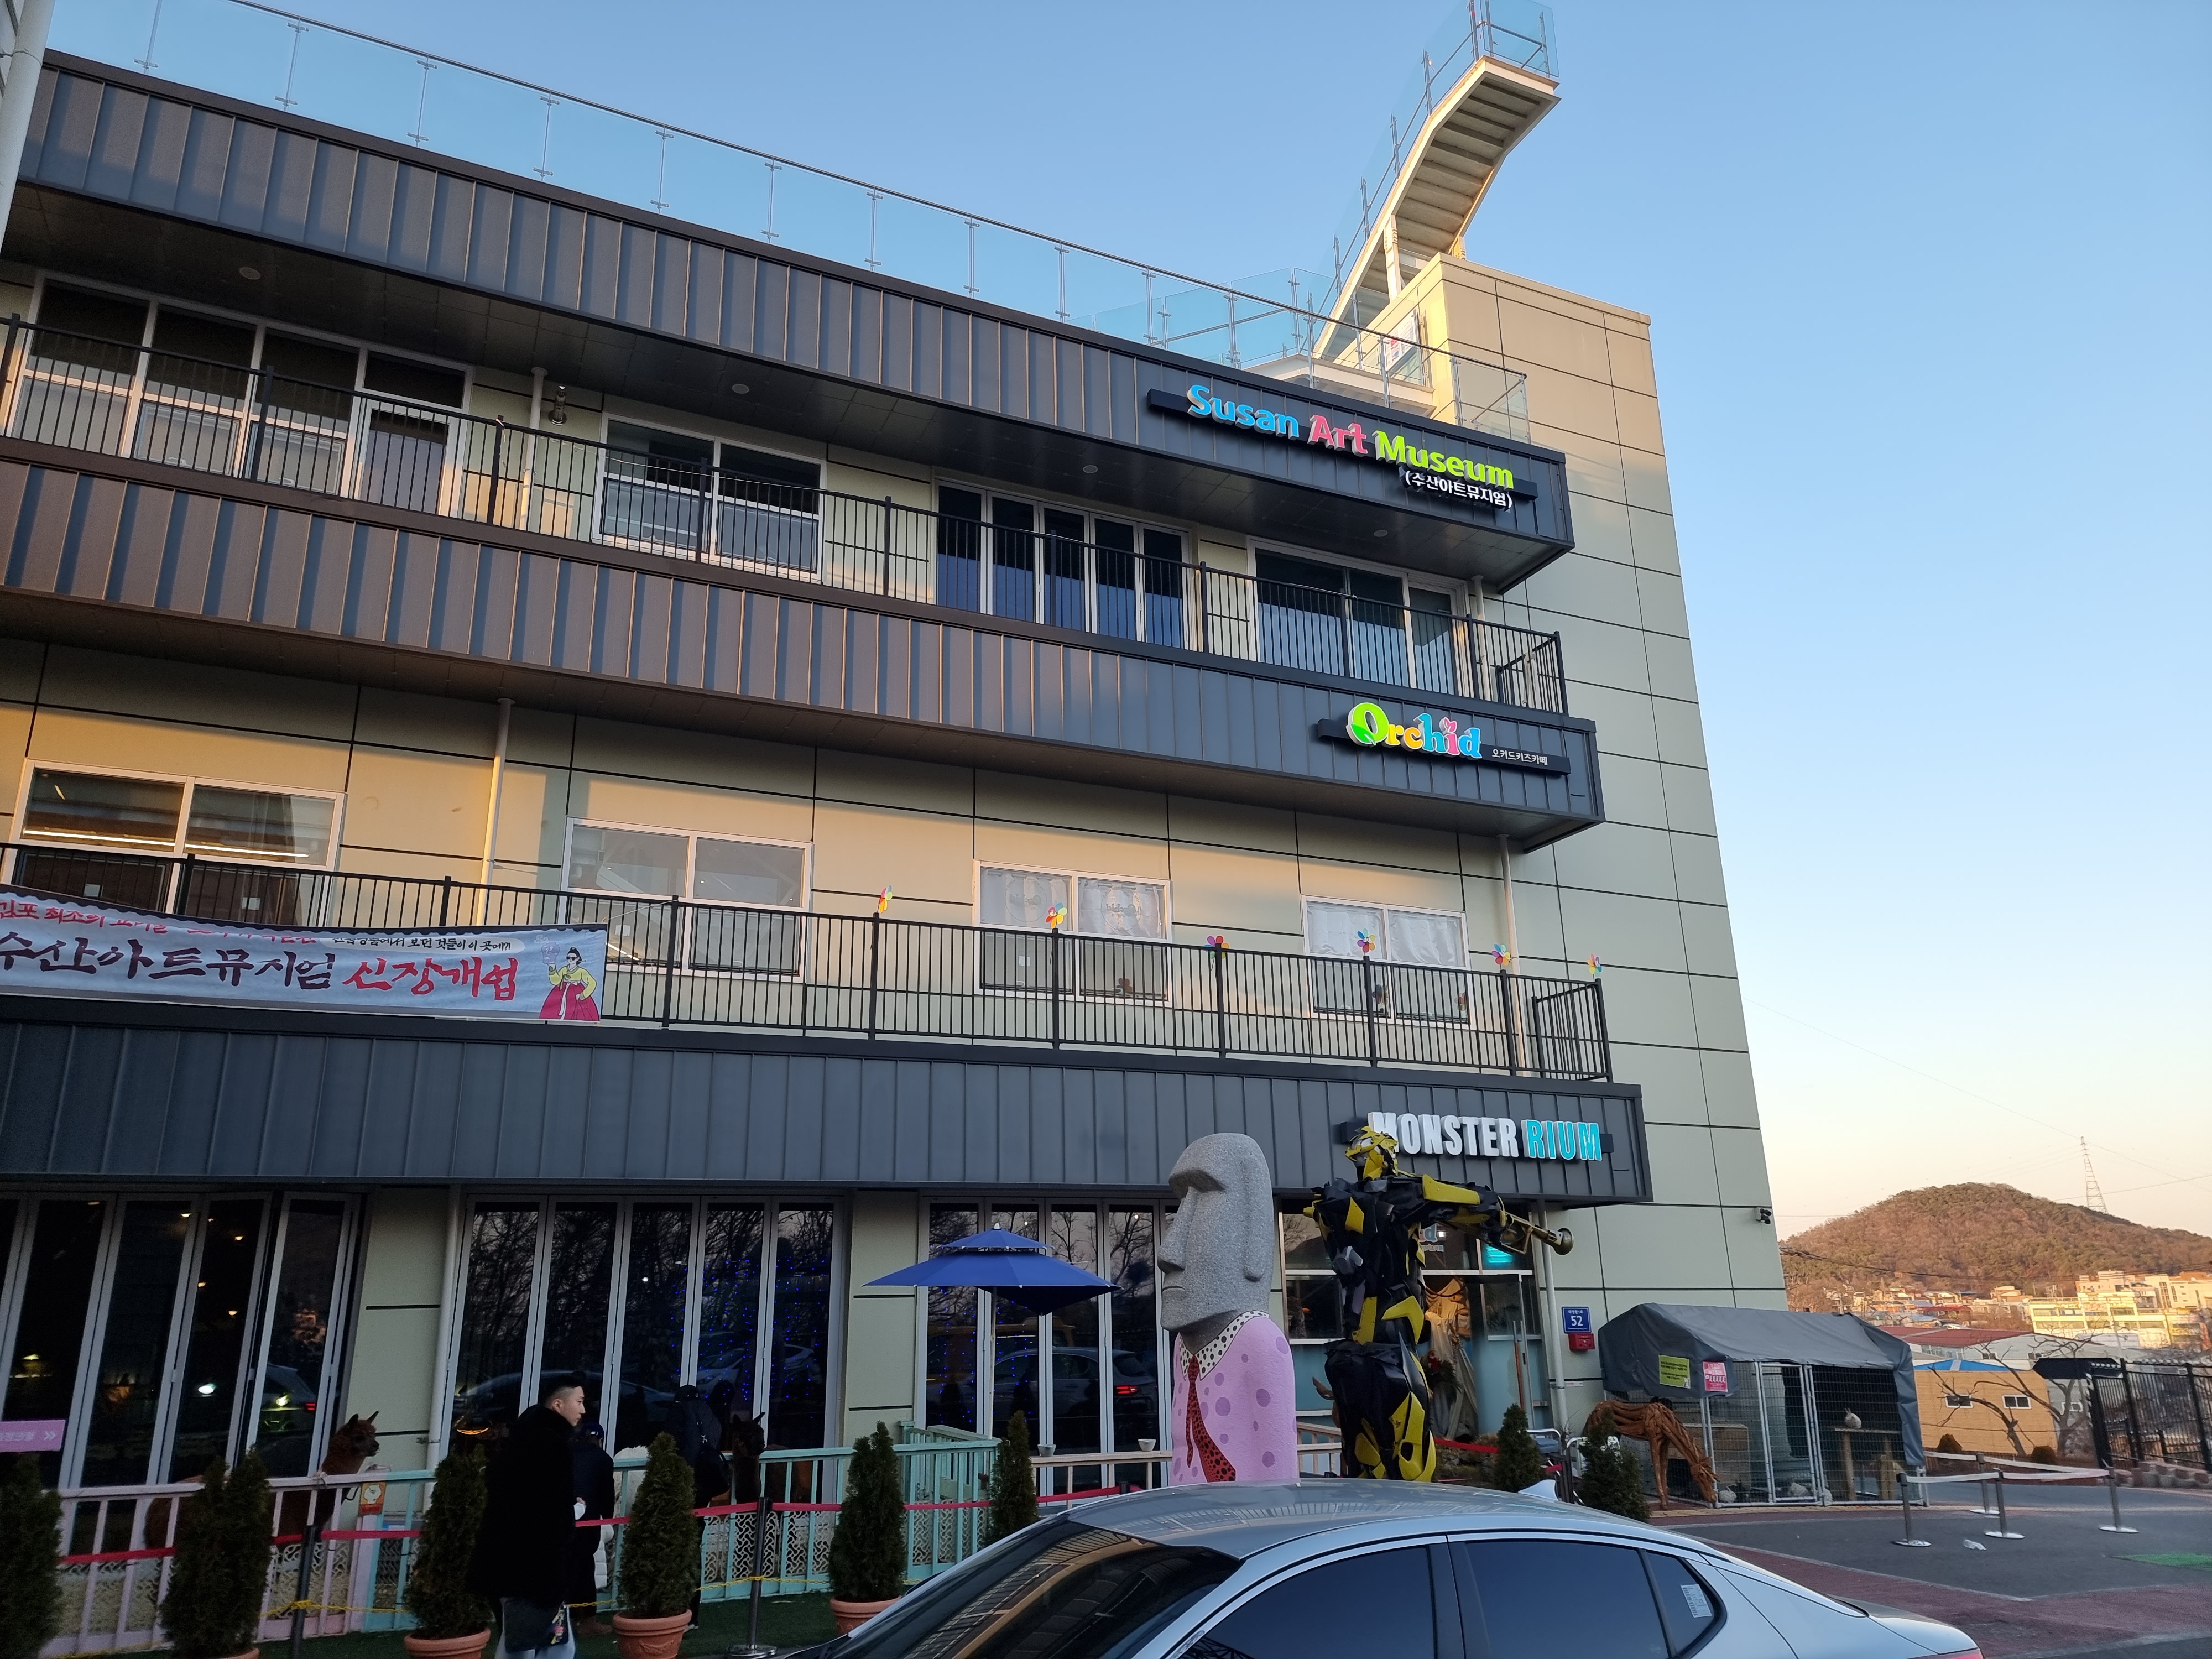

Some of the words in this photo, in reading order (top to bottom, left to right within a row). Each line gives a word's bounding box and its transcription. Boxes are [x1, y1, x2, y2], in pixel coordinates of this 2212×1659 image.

[1187, 384, 1299, 439] Susan
[1307, 414, 1369, 455] Art
[1373, 430, 1514, 490] Museum
[1405, 471, 1512, 509] (수산아트뮤지엄)
[1347, 702, 1483, 760] Orchid
[1491, 749, 1548, 766] 오키드키즈카페
[0, 899, 39, 919] 김포
[407, 938, 432, 948] 보던
[435, 938, 466, 950] 것들이
[468, 940, 478, 951] 이
[0, 931, 335, 990] 수산아트뮤지엄
[342, 956, 519, 1001] 신장개업
[1368, 1112, 1519, 1157] MONSTER
[1521, 1119, 1603, 1162] RIUM
[1571, 1315, 1583, 1326] 52
